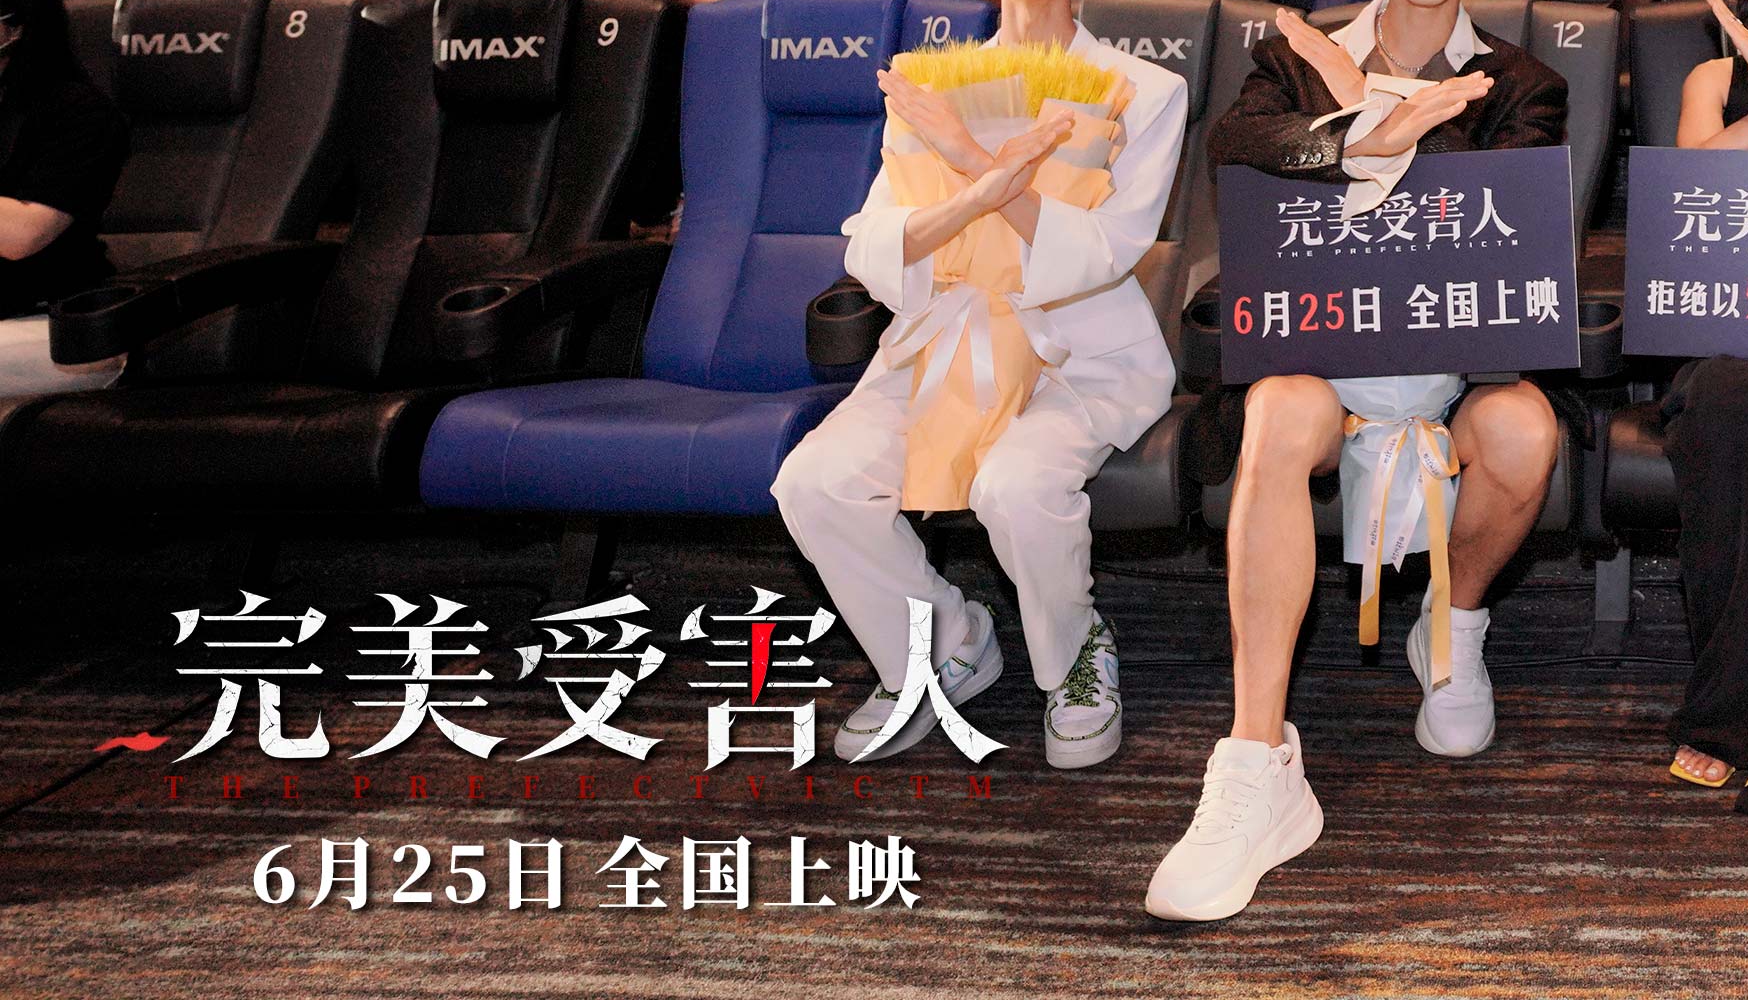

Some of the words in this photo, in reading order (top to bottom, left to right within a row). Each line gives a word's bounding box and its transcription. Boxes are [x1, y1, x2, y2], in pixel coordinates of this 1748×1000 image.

[285, 9, 308, 39] 8
[596, 17, 620, 48] 9
[921, 15, 952, 44] 10
[1552, 20, 1585, 49] 12
[120, 31, 229, 57] IMAX
[439, 34, 546, 62] IMAX
[770, 35, 873, 60] IMAX
[1277, 186, 1518, 250] 完美受害人
[1276, 250, 1314, 259] THE
[1334, 243, 1433, 257] PREFECT
[1669, 244, 1710, 254] THE
[1233, 285, 1382, 339] 6月25日
[1405, 276, 1561, 331] 全国上映
